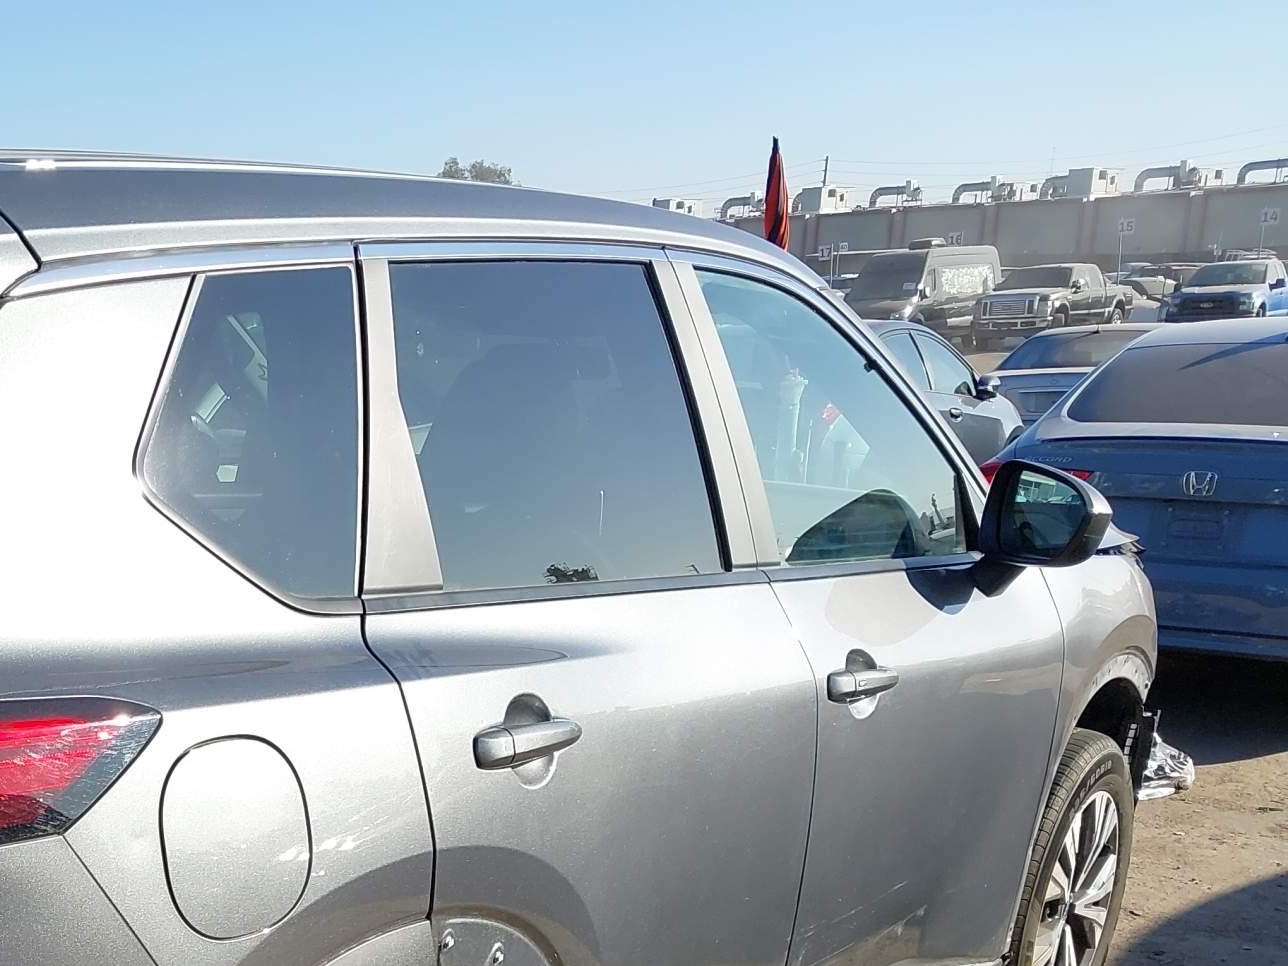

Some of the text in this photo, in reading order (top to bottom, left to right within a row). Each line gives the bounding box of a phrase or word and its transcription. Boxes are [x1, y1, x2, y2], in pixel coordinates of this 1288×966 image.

[1262, 210, 1279, 223] 14
[1119, 221, 1134, 233] 15
[820, 247, 831, 258] 17
